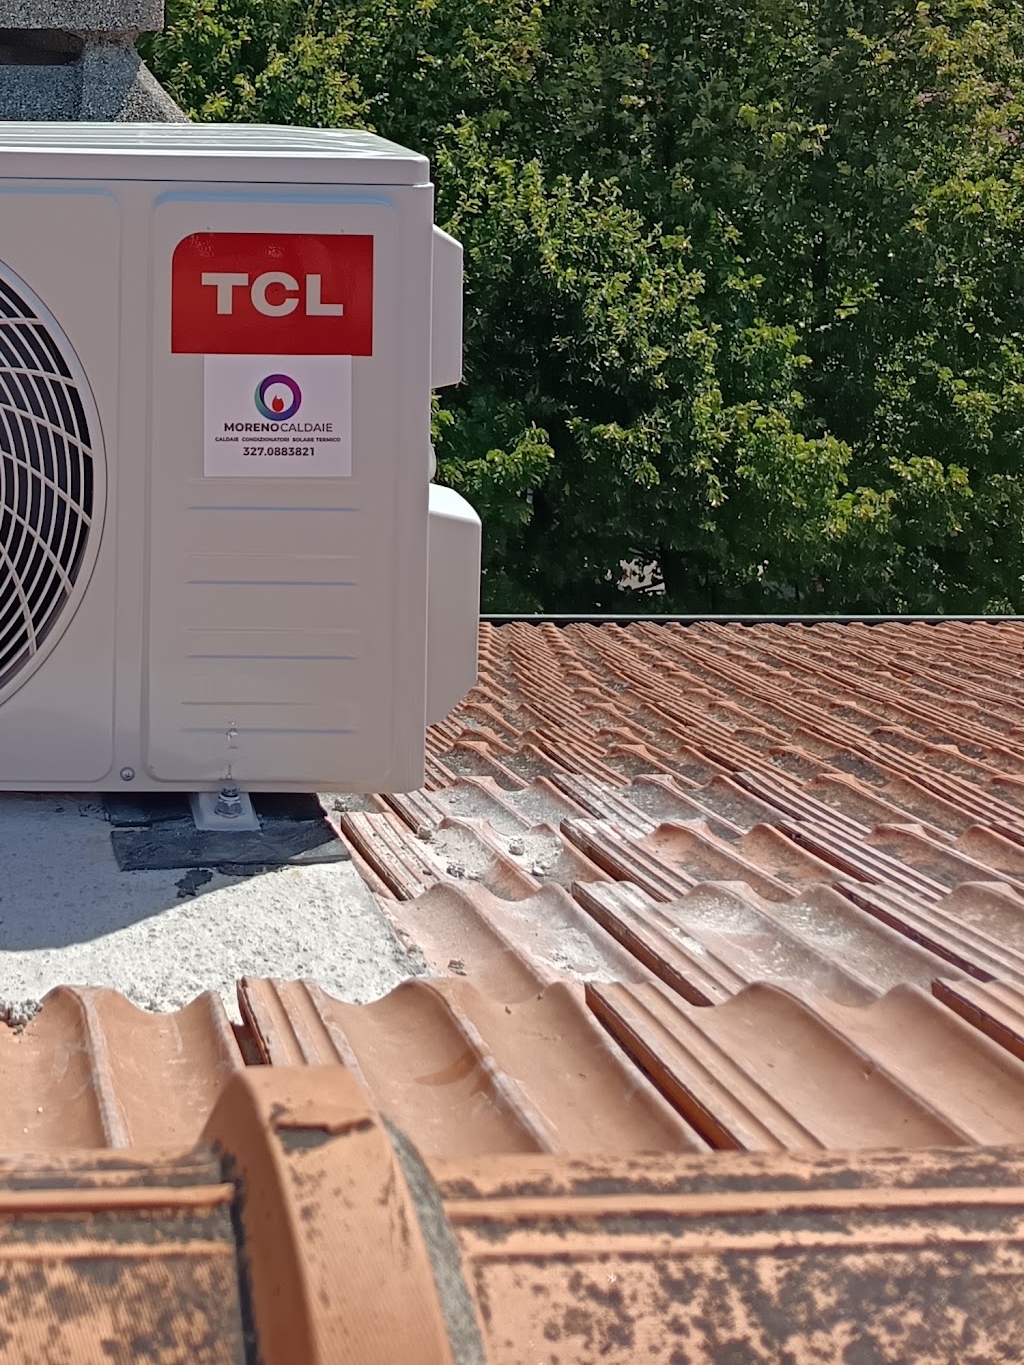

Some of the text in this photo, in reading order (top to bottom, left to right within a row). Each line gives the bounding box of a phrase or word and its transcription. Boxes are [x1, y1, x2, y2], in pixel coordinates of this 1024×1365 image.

[201, 271, 344, 317] TCL
[224, 422, 333, 432] MORENOCALDAIE
[243, 447, 315, 456] 327.0883821
